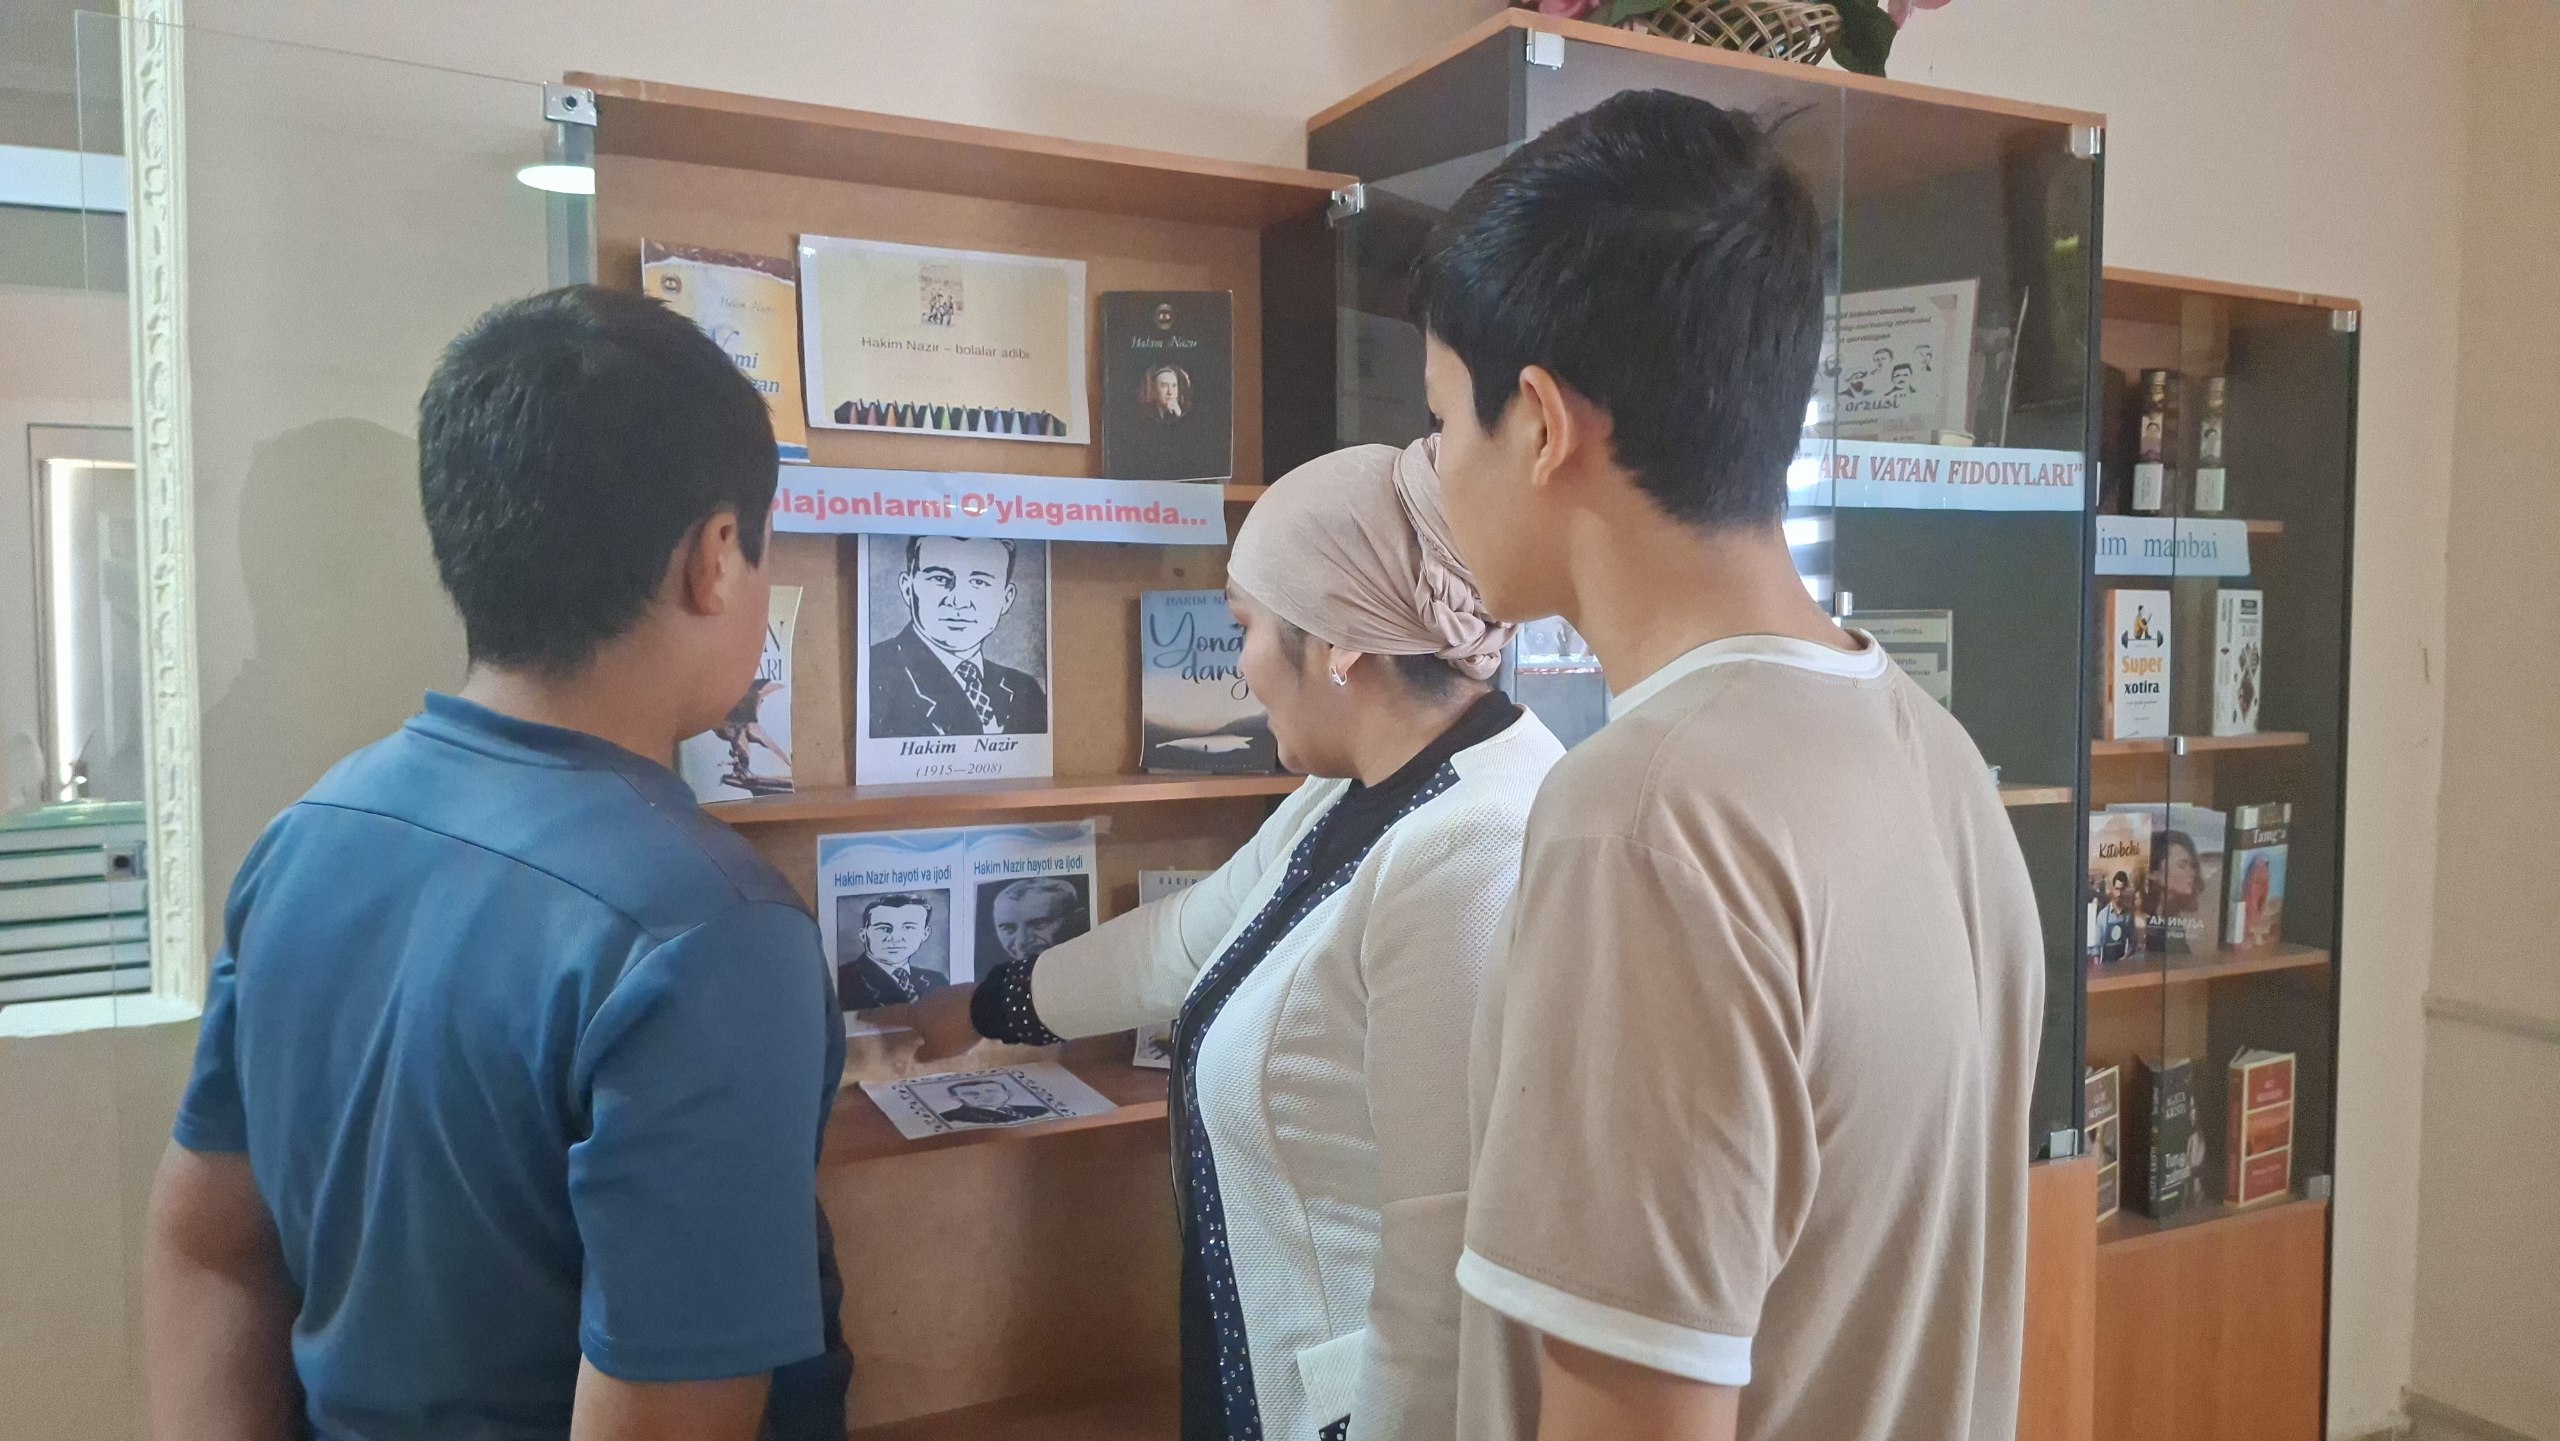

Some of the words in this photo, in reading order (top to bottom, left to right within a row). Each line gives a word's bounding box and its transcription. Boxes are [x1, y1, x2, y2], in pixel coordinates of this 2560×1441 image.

[862, 336, 903, 350] Hakim
[906, 340, 940, 352] Nazir
[955, 344, 997, 357] bolalar
[1819, 453, 1860, 479] ARI
[1870, 456, 1940, 483] VATAN
[2097, 528, 2128, 556] im
[2143, 531, 2218, 558] manbai
[2121, 655, 2164, 677] Super
[2124, 680, 2160, 695] xotira
[900, 740, 957, 756] Hakim
[974, 738, 1019, 753] Nazir
[974, 861, 1001, 875] Hakim
[1003, 858, 1026, 873] Nazir
[1027, 857, 1052, 875] hayoti
[1054, 858, 1064, 870] va
[1065, 855, 1083, 873] ijodi
[834, 871, 864, 887] Hakim
[866, 869, 890, 885] Nazir
[892, 867, 919, 886] hayoti
[921, 869, 931, 881] va
[933, 865, 952, 884] ijodi
